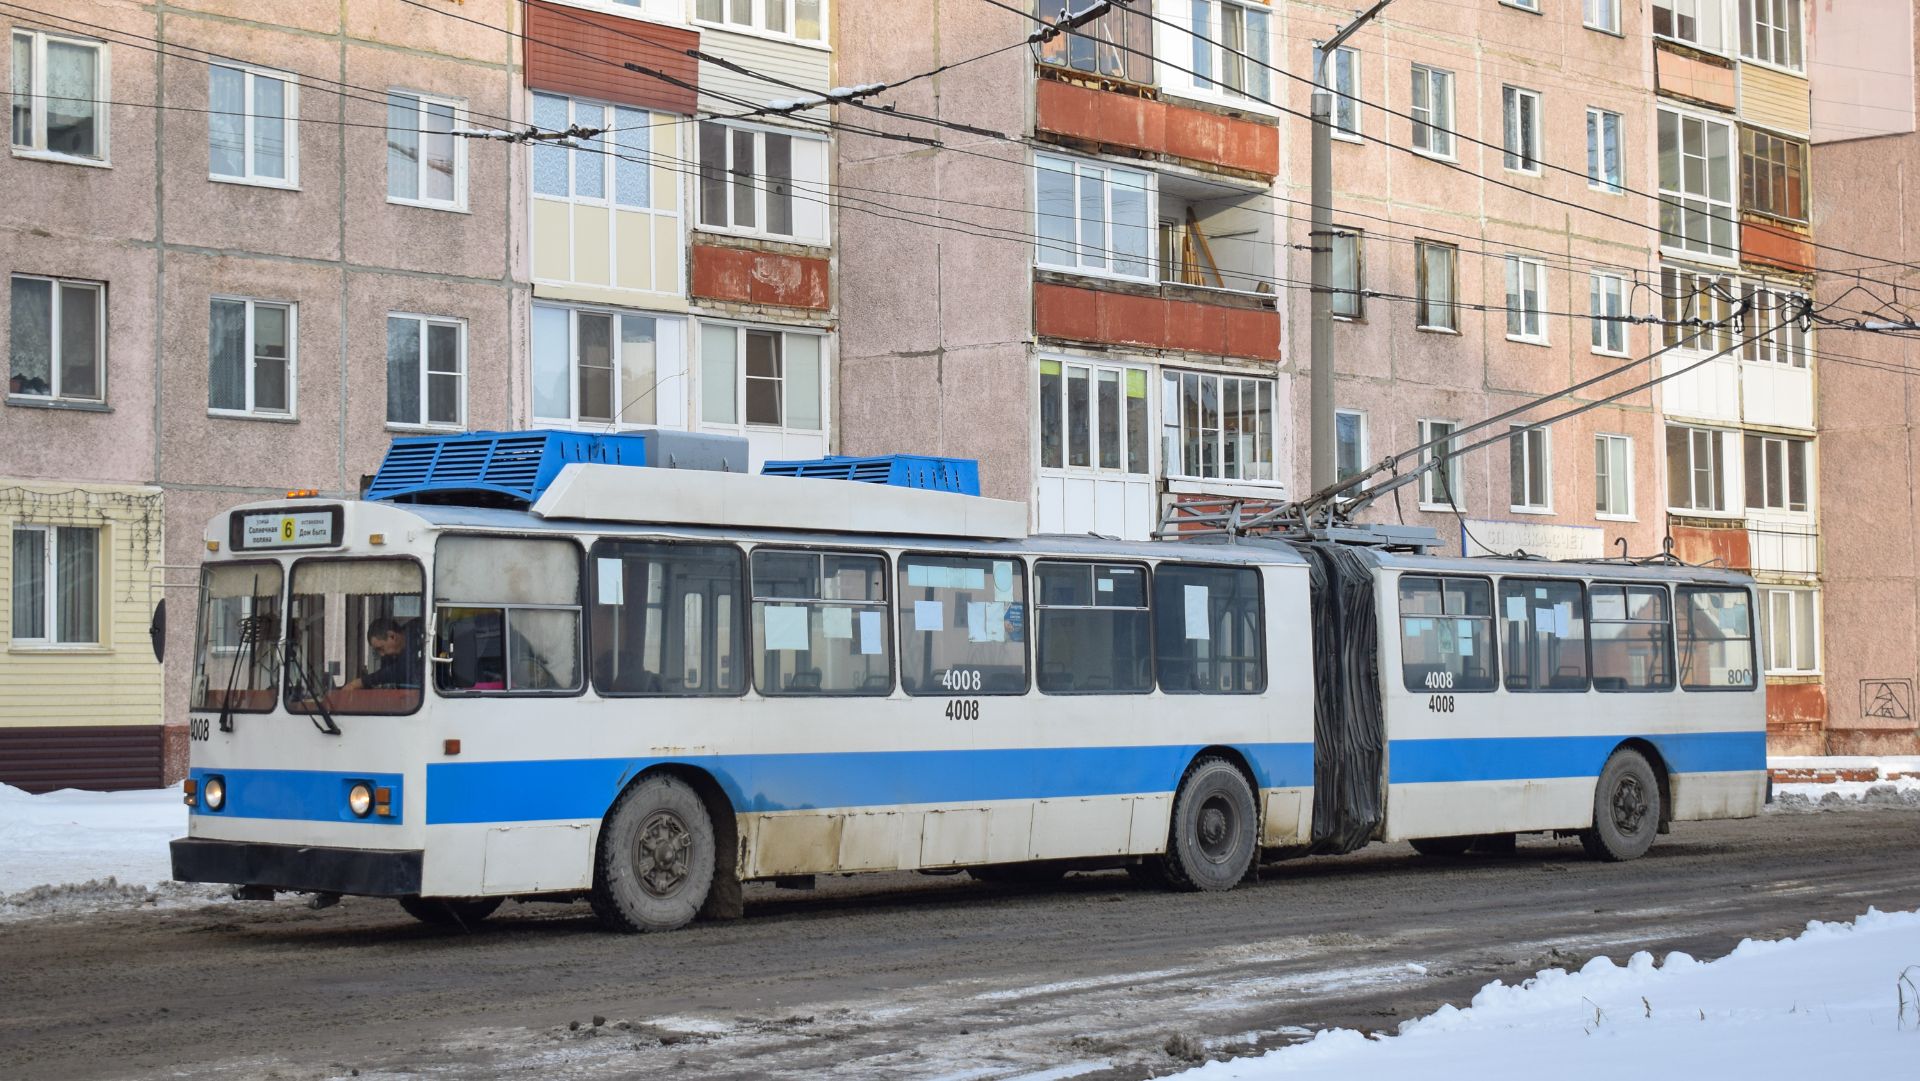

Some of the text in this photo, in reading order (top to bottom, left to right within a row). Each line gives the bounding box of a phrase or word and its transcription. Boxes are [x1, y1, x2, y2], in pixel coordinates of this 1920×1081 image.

[248, 526, 278, 534] Солнечная
[285, 521, 292, 538] 6
[299, 528, 327, 537] Дом быта
[942, 669, 981, 690] 4008
[1424, 671, 1454, 689] 4008
[945, 700, 979, 720] 4008
[1428, 694, 1455, 713] 4008
